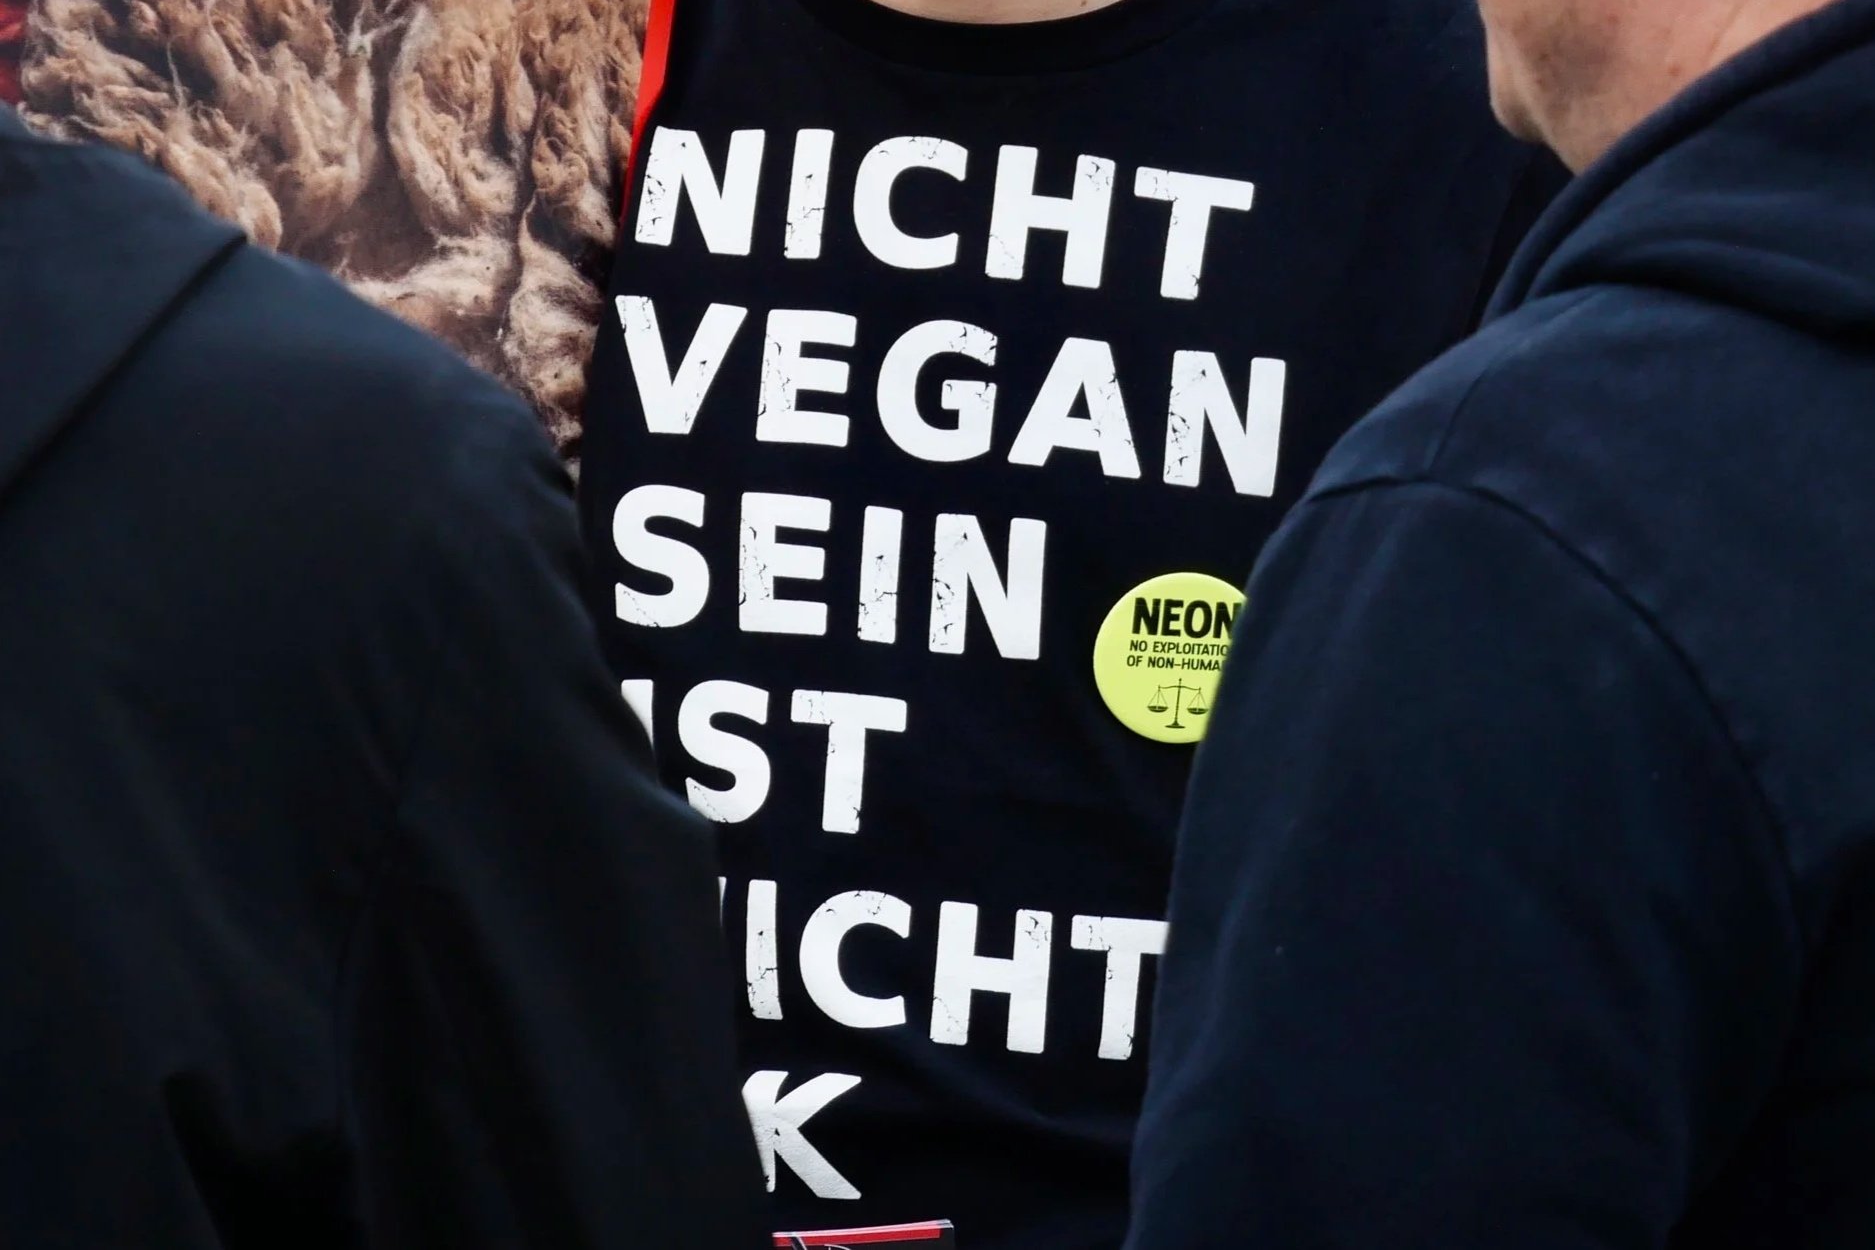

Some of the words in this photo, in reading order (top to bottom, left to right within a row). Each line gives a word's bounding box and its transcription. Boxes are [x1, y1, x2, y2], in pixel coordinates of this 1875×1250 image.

[634, 125, 1255, 301] NICHT
[614, 294, 1286, 498] VEGAN
[612, 484, 1047, 661] SEIN
[1129, 639, 1148, 653] NO
[1131, 597, 1242, 639] NEON
[1126, 654, 1143, 667] OF
[1147, 655, 1226, 672] NON-HUMA
[620, 678, 908, 835] ST
[717, 876, 1170, 1060] ICHT
